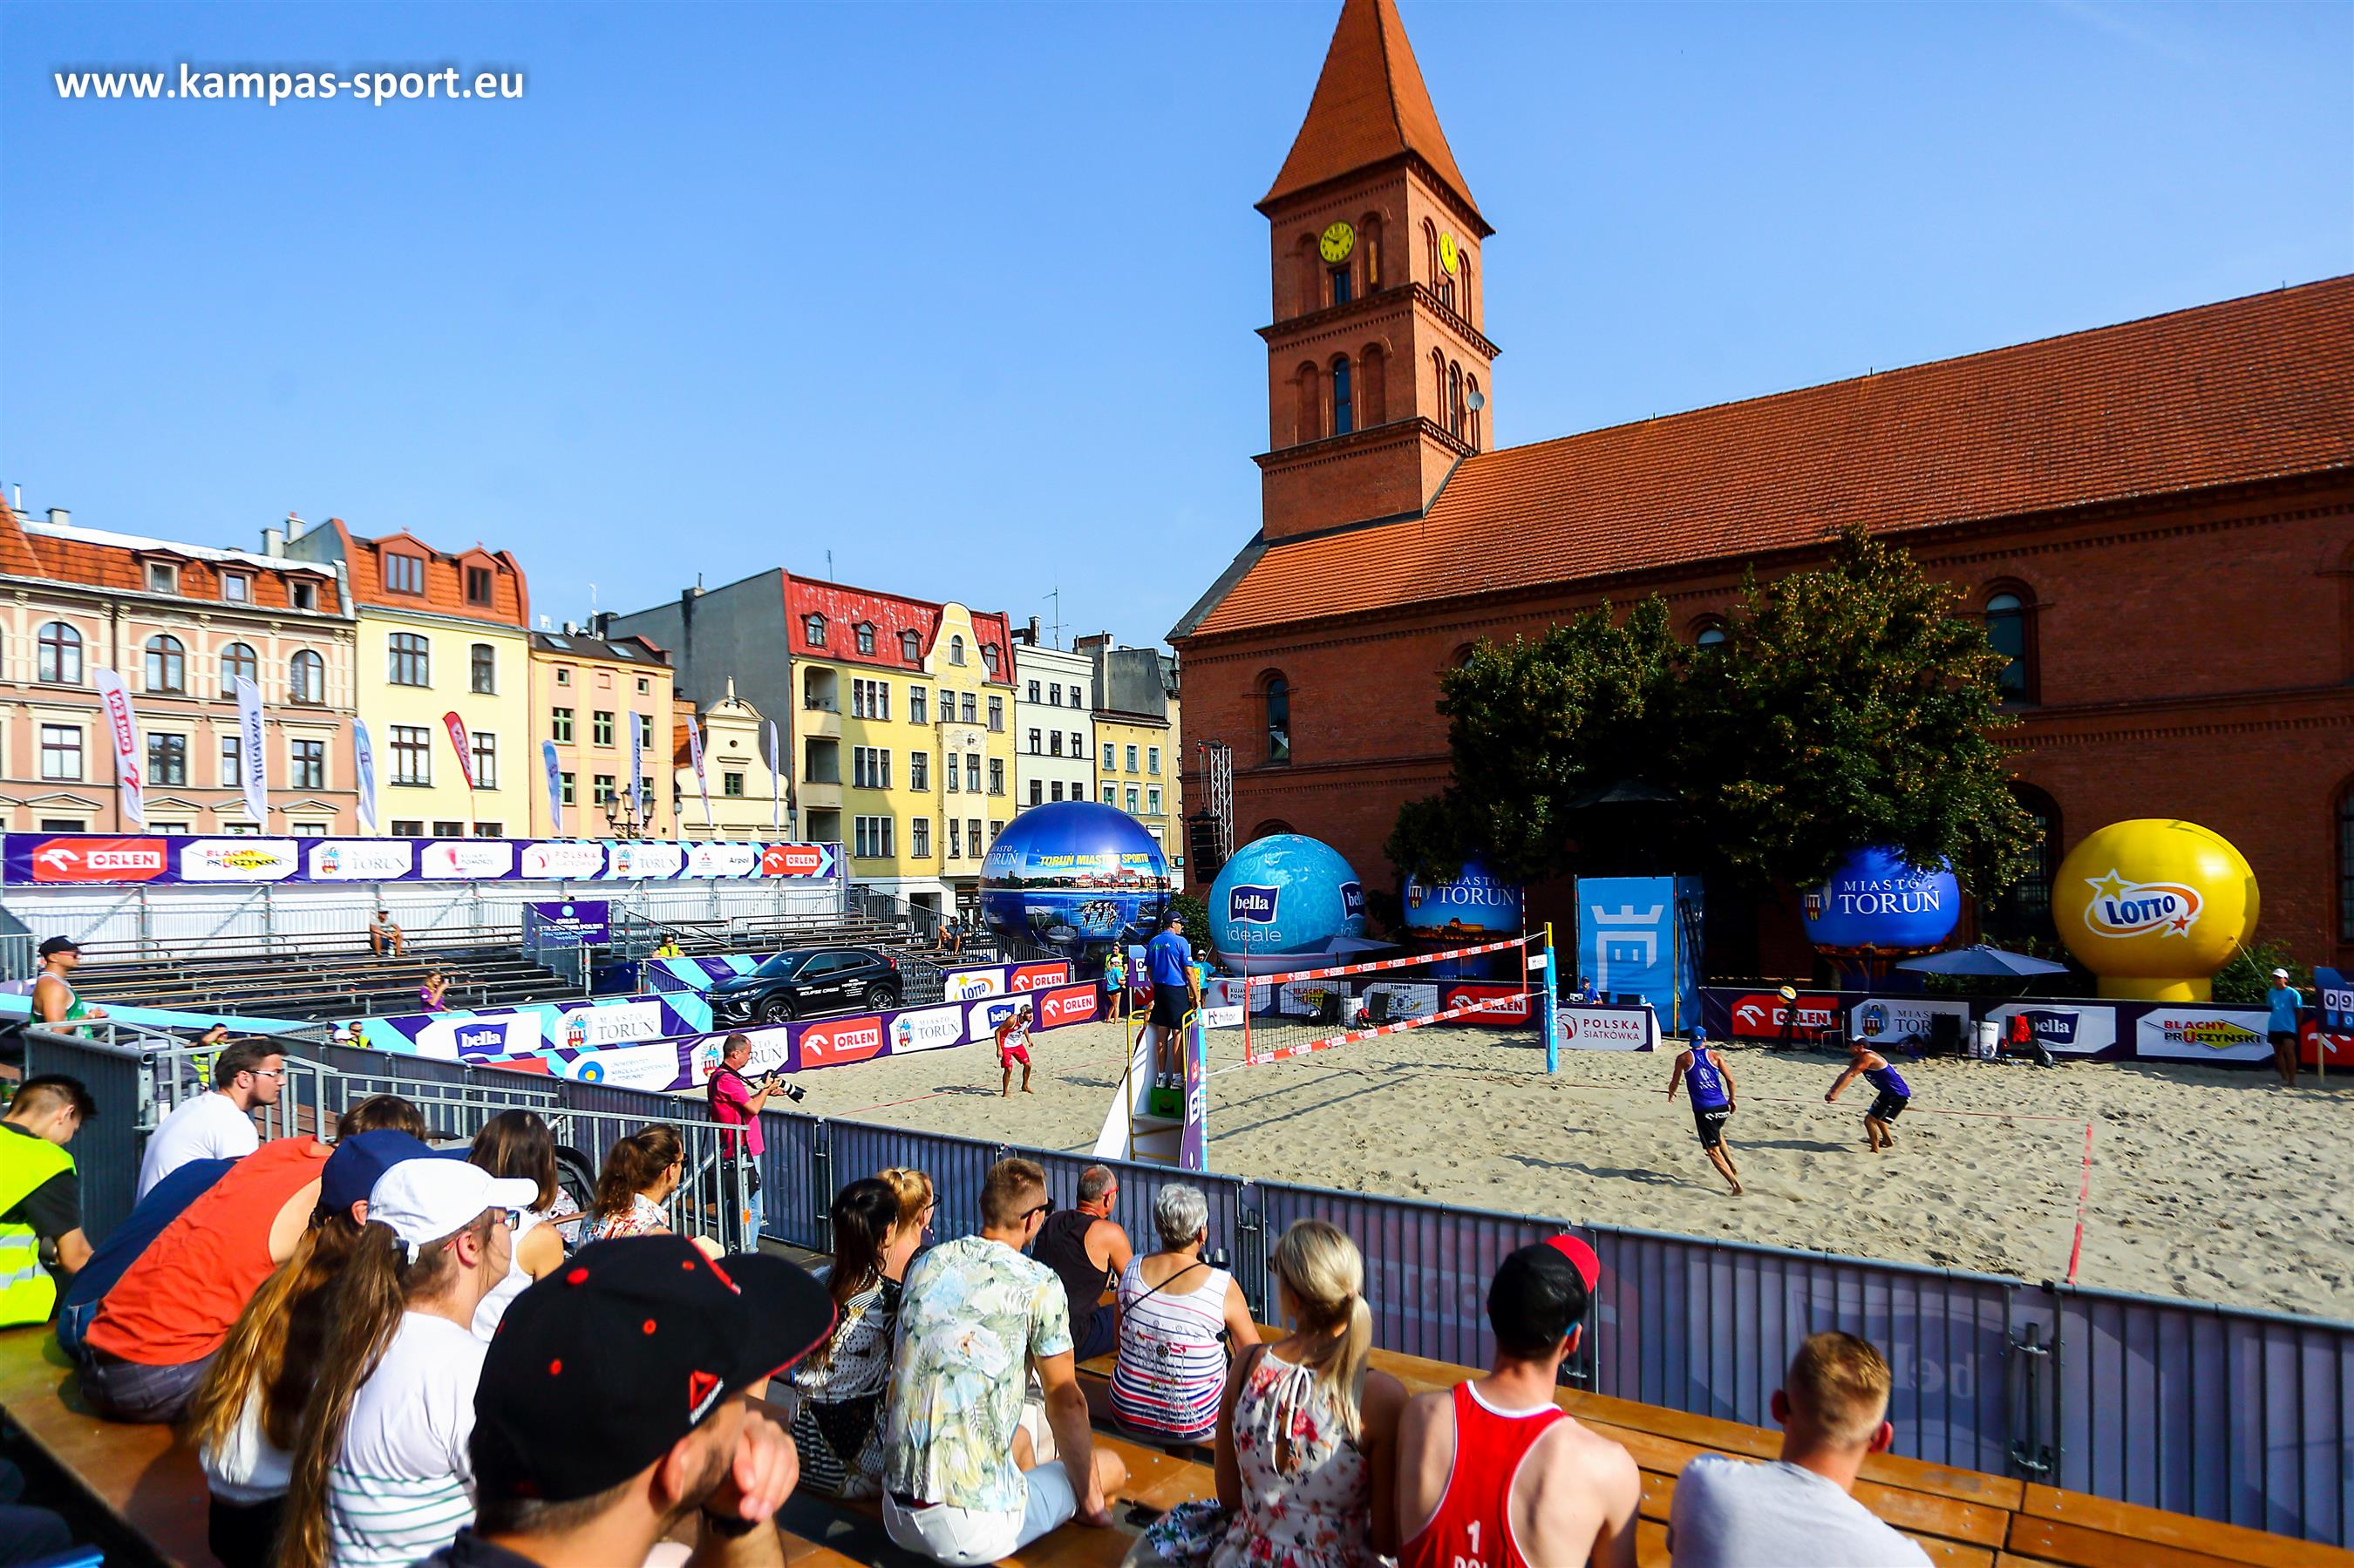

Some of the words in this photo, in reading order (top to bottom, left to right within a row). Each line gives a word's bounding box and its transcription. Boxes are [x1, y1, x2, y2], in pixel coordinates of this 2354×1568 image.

[93, 854, 154, 865] ORLEN
[206, 849, 256, 858] BLACHY
[1121, 852, 1149, 864] SPORTU
[1843, 879, 1920, 892] MIASTO
[1235, 894, 1269, 911] bella
[2105, 895, 2176, 926] LOTTO
[1226, 926, 1282, 942] ideale
[1034, 975, 1062, 987] ORLEN
[962, 982, 986, 1000] LOTTO
[1065, 998, 1092, 1010] ORLEN
[1293, 995, 1323, 1004] PRUSZY
[2326, 993, 2352, 1008] 09
[1219, 1011, 1236, 1023] hitor
[1776, 1010, 1830, 1025] OLEN
[1582, 1018, 1640, 1030] POLSKA
[1895, 1018, 1932, 1033] TOR
[2163, 1020, 2226, 1031] BLACHY
[460, 1029, 502, 1049] bella
[1583, 1028, 1640, 1040] SIATKÓWKA
[2163, 1028, 2262, 1045] PRUSZYŃSKI
[837, 1032, 876, 1049] ORLEN
[1296, 1045, 1310, 1054] ORLEN
[1258, 1054, 1274, 1062] ORLEN
[1467, 1519, 1480, 1555] 1
